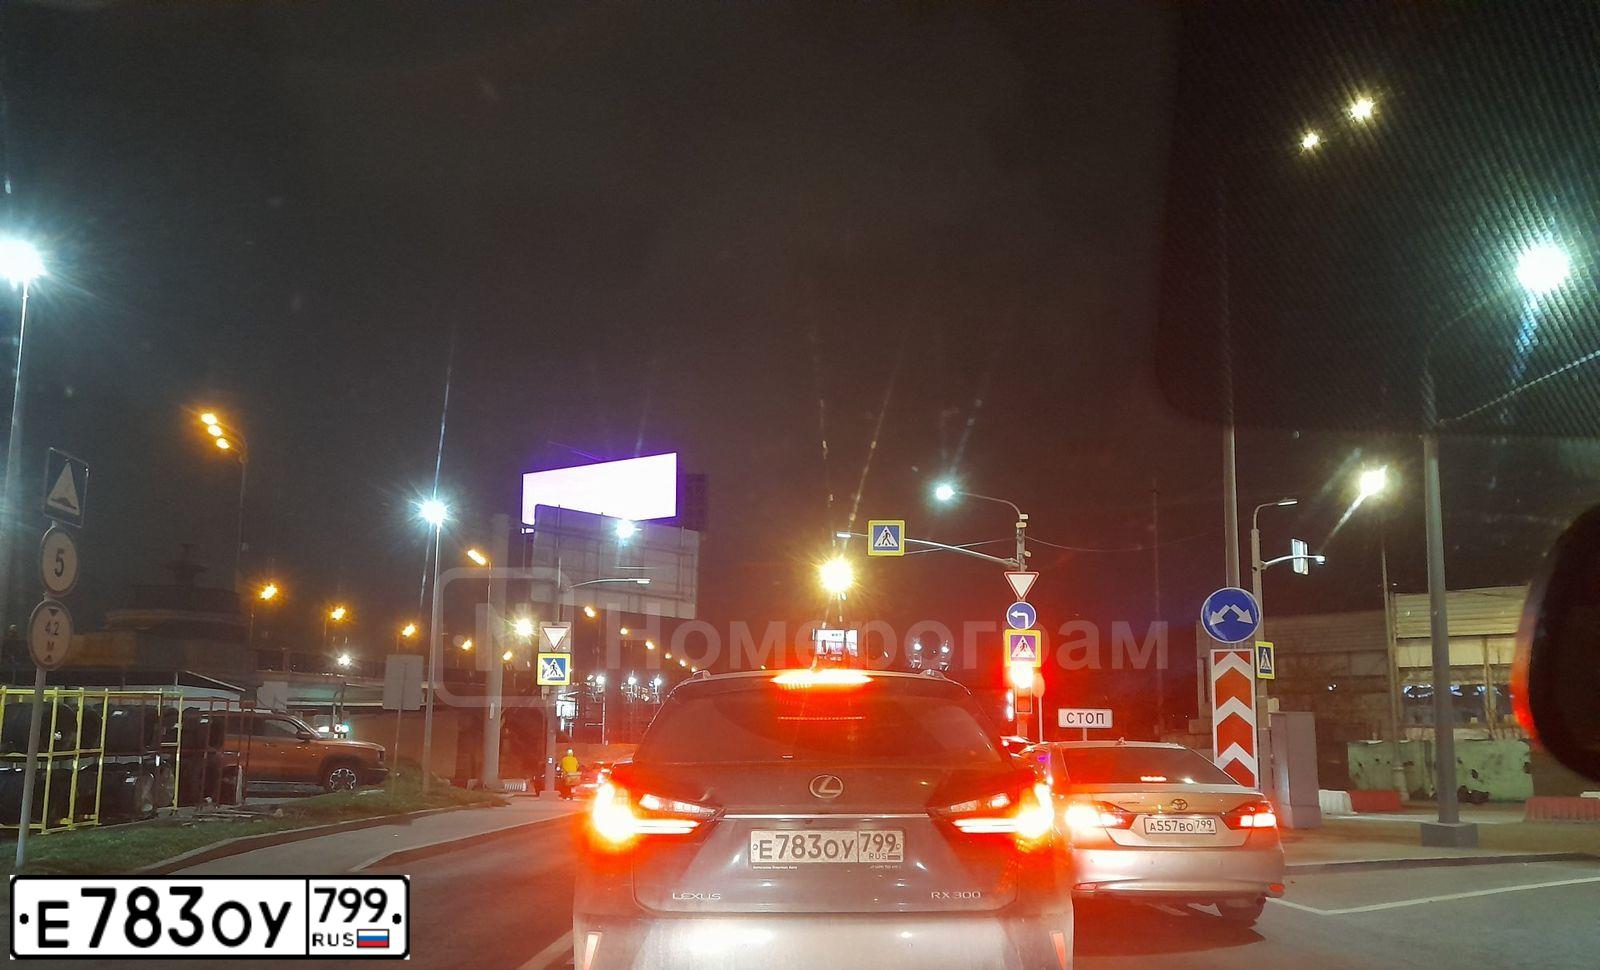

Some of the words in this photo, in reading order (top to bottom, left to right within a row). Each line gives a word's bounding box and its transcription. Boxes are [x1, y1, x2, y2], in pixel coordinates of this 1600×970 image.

[54, 548, 65, 578] 5
[1066, 712, 1105, 724] СТОП
[860, 833, 896, 854] 799
[868, 852, 887, 860] RUS
[672, 892, 721, 900] LEXUS
[931, 891, 951, 899] RX
[953, 891, 981, 899] 300
